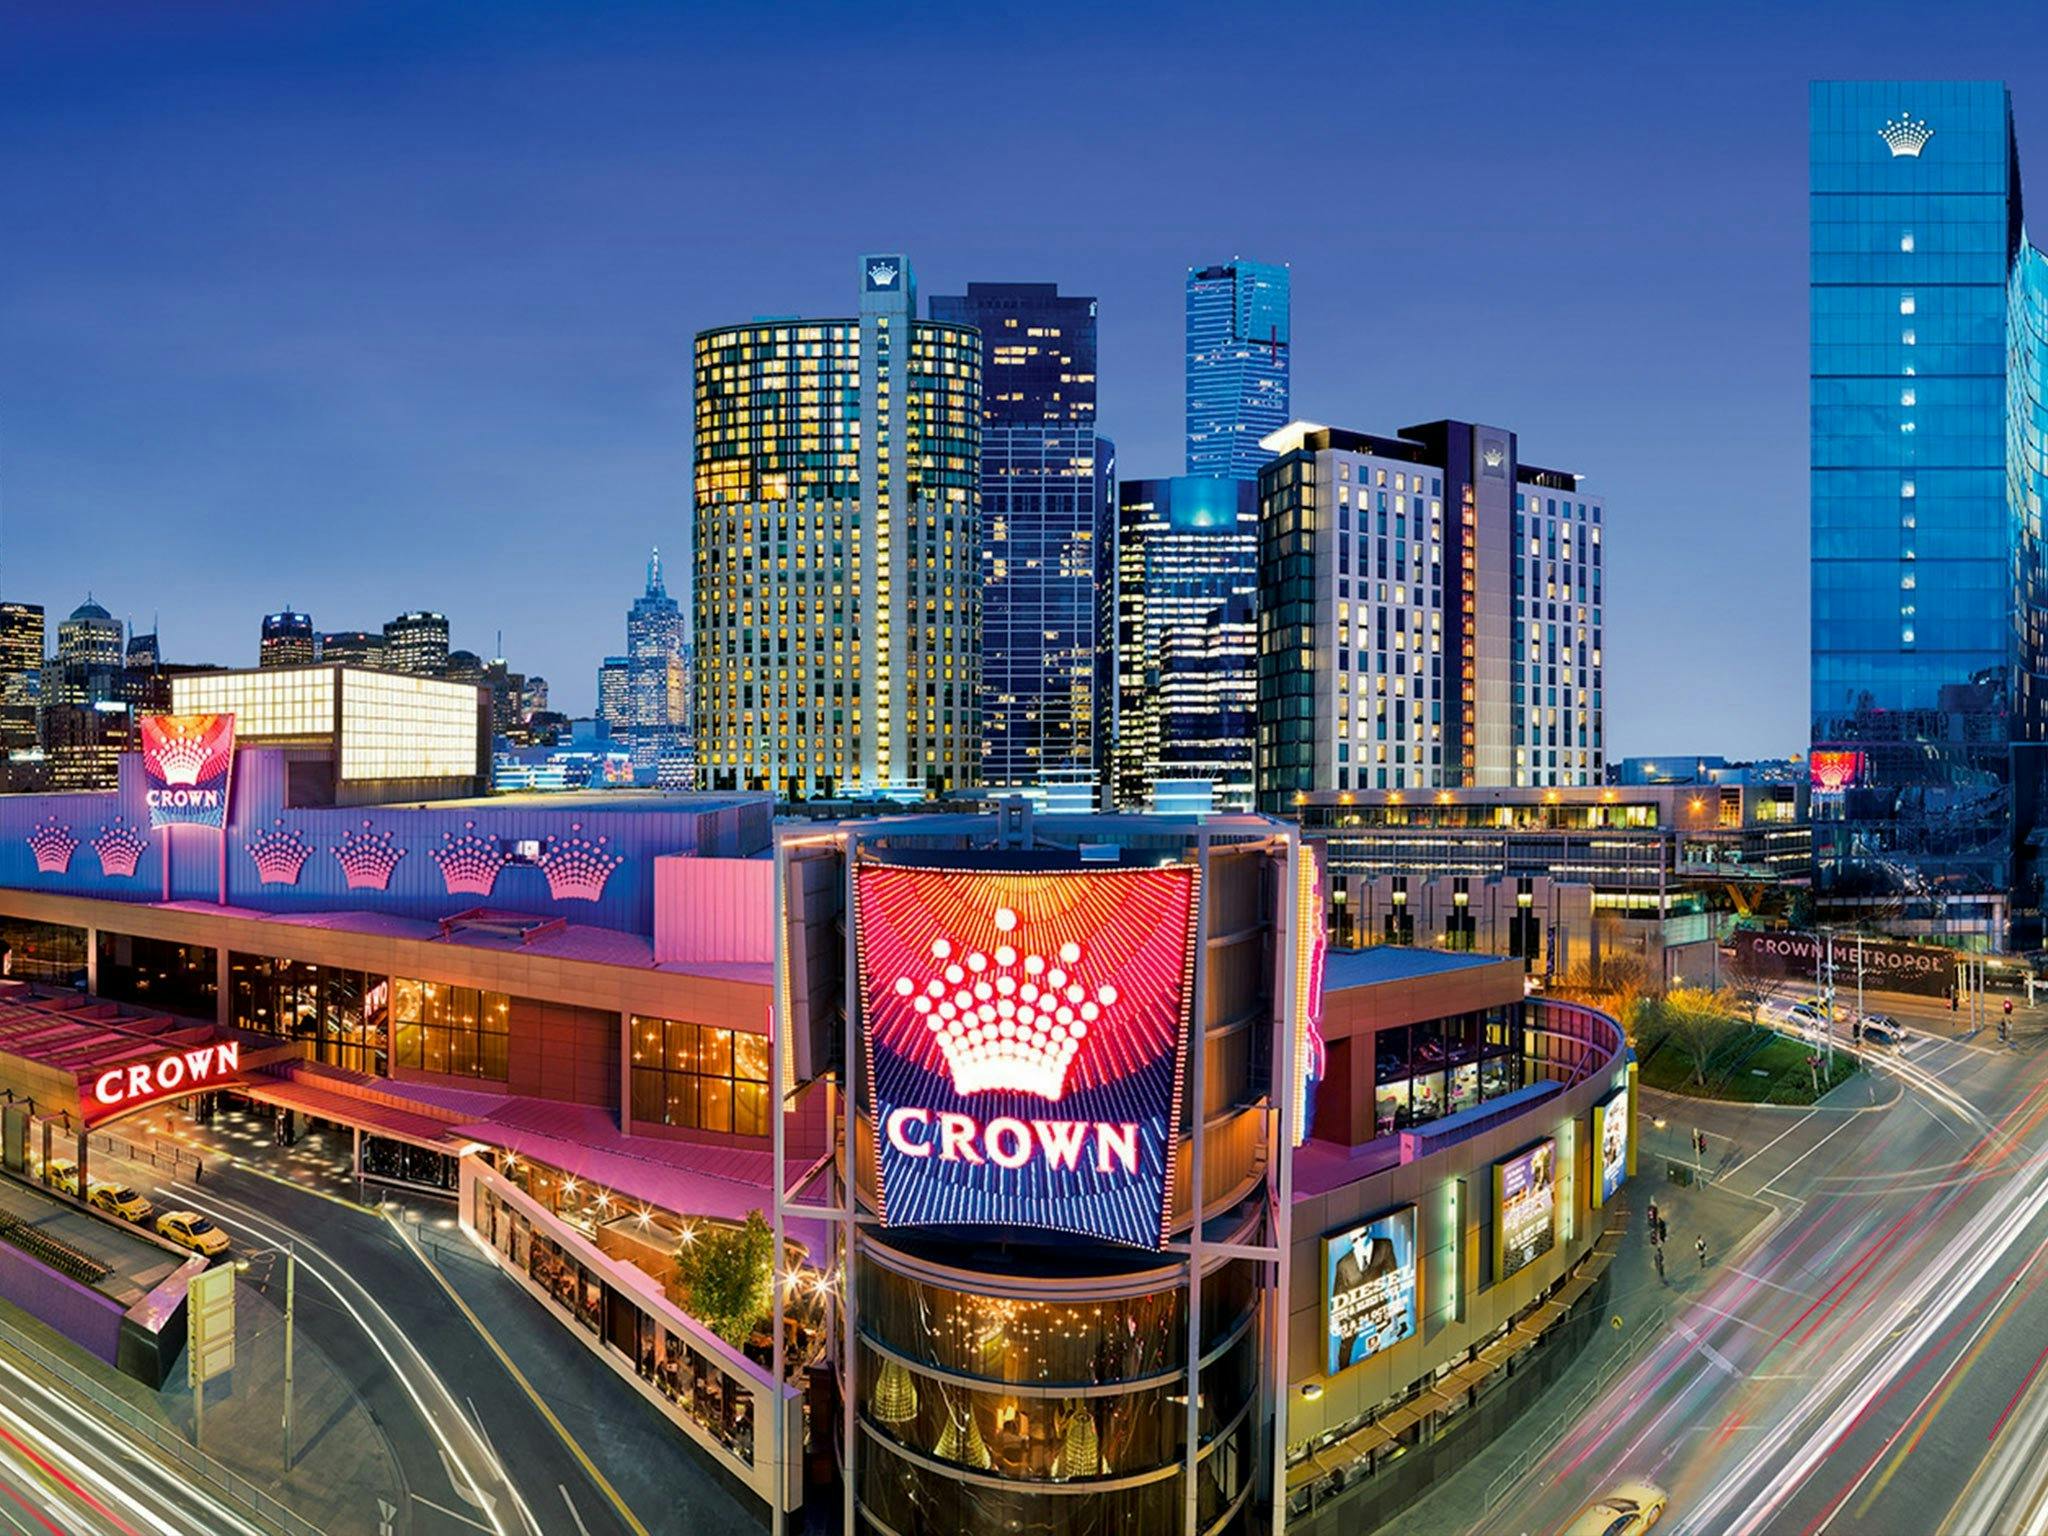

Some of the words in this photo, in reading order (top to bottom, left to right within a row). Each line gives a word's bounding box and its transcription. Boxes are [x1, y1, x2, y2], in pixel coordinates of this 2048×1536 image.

[146, 789, 218, 808] CROWN
[1753, 938, 1825, 960] CROWN
[95, 1041, 239, 1105] CROWN
[887, 1106, 1140, 1176] CROWN
[1330, 1264, 1415, 1313] DIESEL
